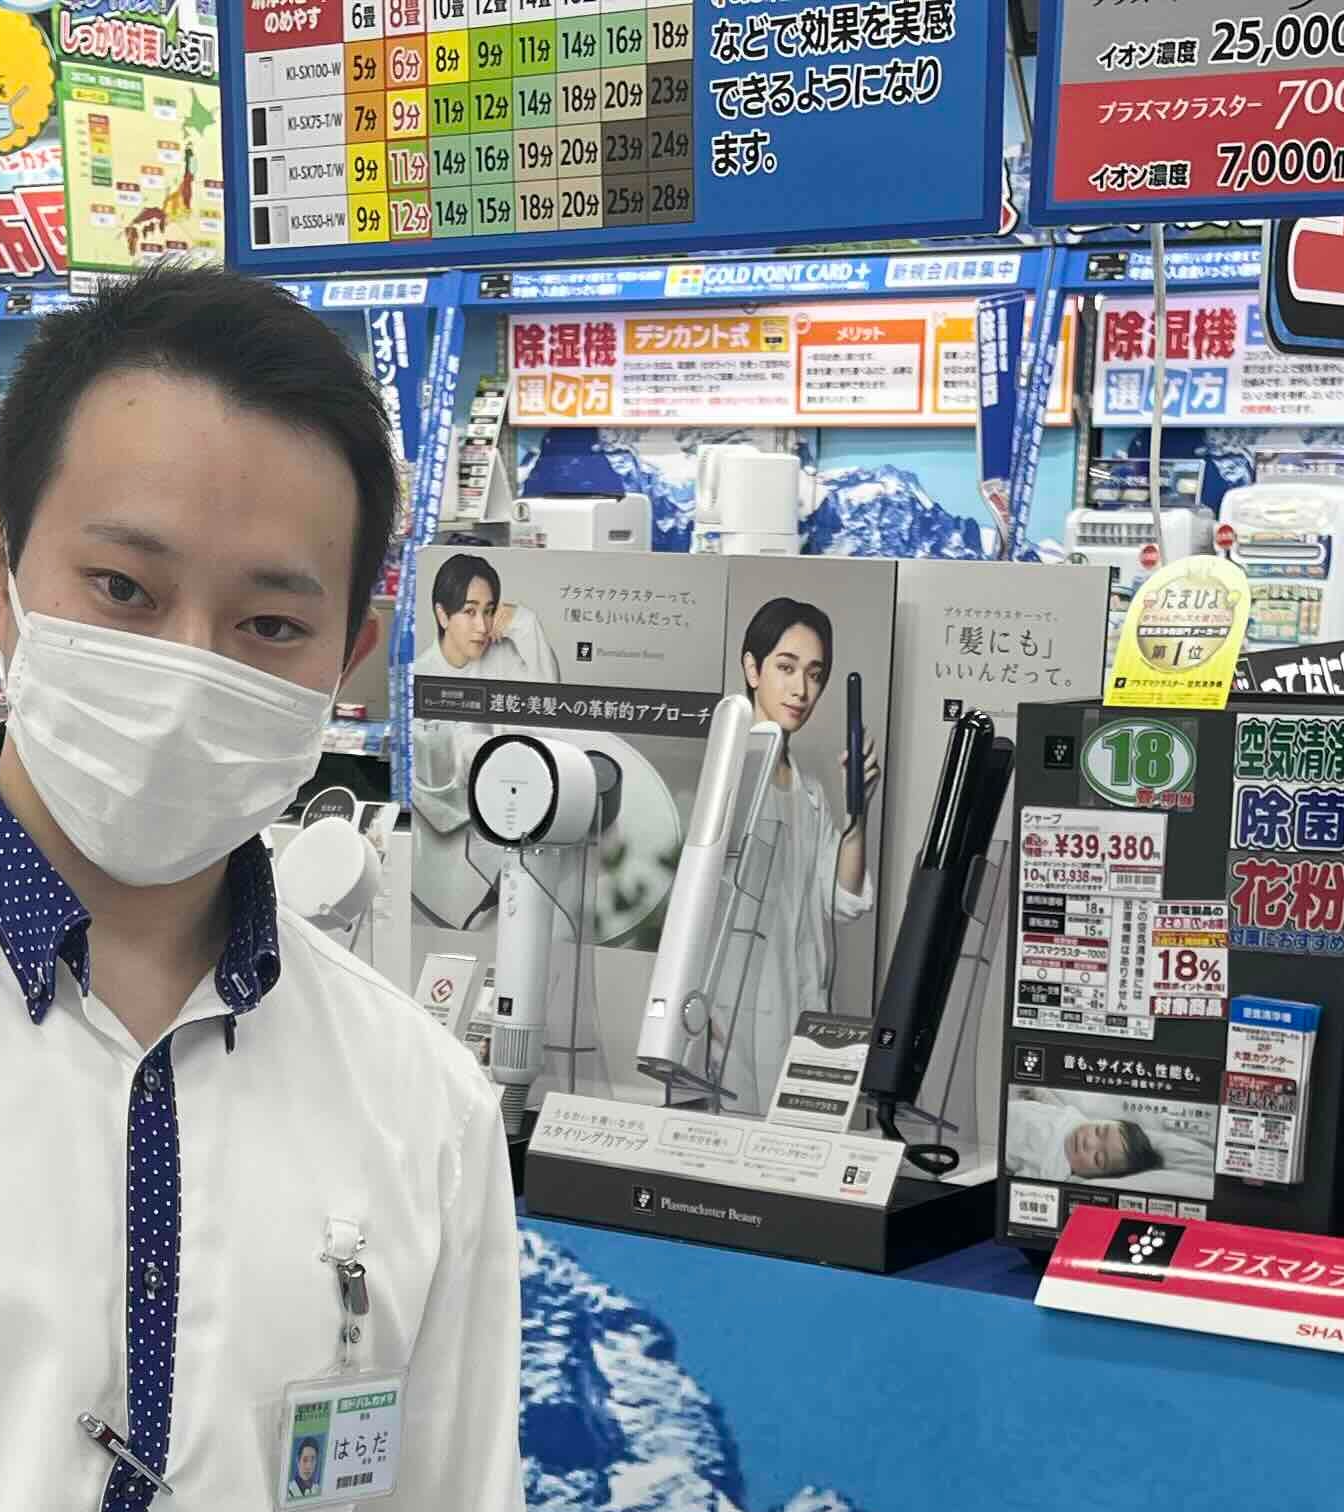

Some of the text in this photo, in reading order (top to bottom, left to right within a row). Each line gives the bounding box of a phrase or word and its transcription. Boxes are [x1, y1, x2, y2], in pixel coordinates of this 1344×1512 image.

[265, 7, 322, 33] のめやす
[352, 1, 377, 28] 6畳
[712, 1, 955, 63] などで効果を実感
[353, 54, 377, 81] 5分
[391, 50, 420, 80] 6分
[435, 46, 459, 73] 8分
[477, 40, 504, 68] 9分
[519, 35, 551, 64] 11分
[562, 30, 596, 59] 14分
[606, 24, 642, 54] 16分
[653, 19, 689, 49] 18分
[1098, 39, 1197, 69] イオン濃度
[355, 105, 377, 132] 7分
[391, 100, 421, 129] 9分
[434, 97, 464, 125] 11分
[474, 93, 509, 121] 12分
[518, 88, 552, 117] 14分
[562, 84, 597, 113] 18分
[604, 78, 643, 108] 20分
[650, 74, 689, 104] 23分
[712, 57, 940, 121] できるようになり
[1098, 94, 1262, 126] プラズマクラスター
[355, 155, 378, 183] 9分
[391, 150, 427, 182] 11分
[434, 148, 466, 176] 14分
[475, 143, 510, 173] 16分
[519, 141, 553, 170] 19分
[560, 136, 598, 167] 20分
[605, 132, 643, 163] 23分
[650, 128, 689, 158] 24分
[712, 131, 777, 176] ます。
[1090, 163, 1190, 190] イオン濃度
[356, 205, 380, 232] 9分
[391, 199, 431, 233] 12分
[436, 198, 467, 226] 14分
[477, 195, 511, 223] 15分
[520, 191, 554, 221] 18分
[561, 187, 599, 218] 20分
[606, 185, 644, 216] 25分
[651, 181, 690, 211] 28分
[704, 263, 851, 286] GOLD POINT CARD
[514, 321, 618, 368] 除湿機
[1102, 309, 1238, 362] 除湿機
[517, 375, 612, 416] 選び方
[559, 606, 691, 629] 「髪にも」いいんだって。
[945, 624, 1056, 659] 「髪にも」
[934, 660, 1074, 688] いいんだって。
[489, 693, 712, 724] 速乾・美髪への革新的アプローチ
[1103, 727, 1175, 788] 18
[1023, 812, 1062, 826] シャープ
[1156, 949, 1222, 983] 18%
[1063, 1054, 1202, 1083] 音も、サイズも、性能も。
[333, 1431, 391, 1461] はらだ
